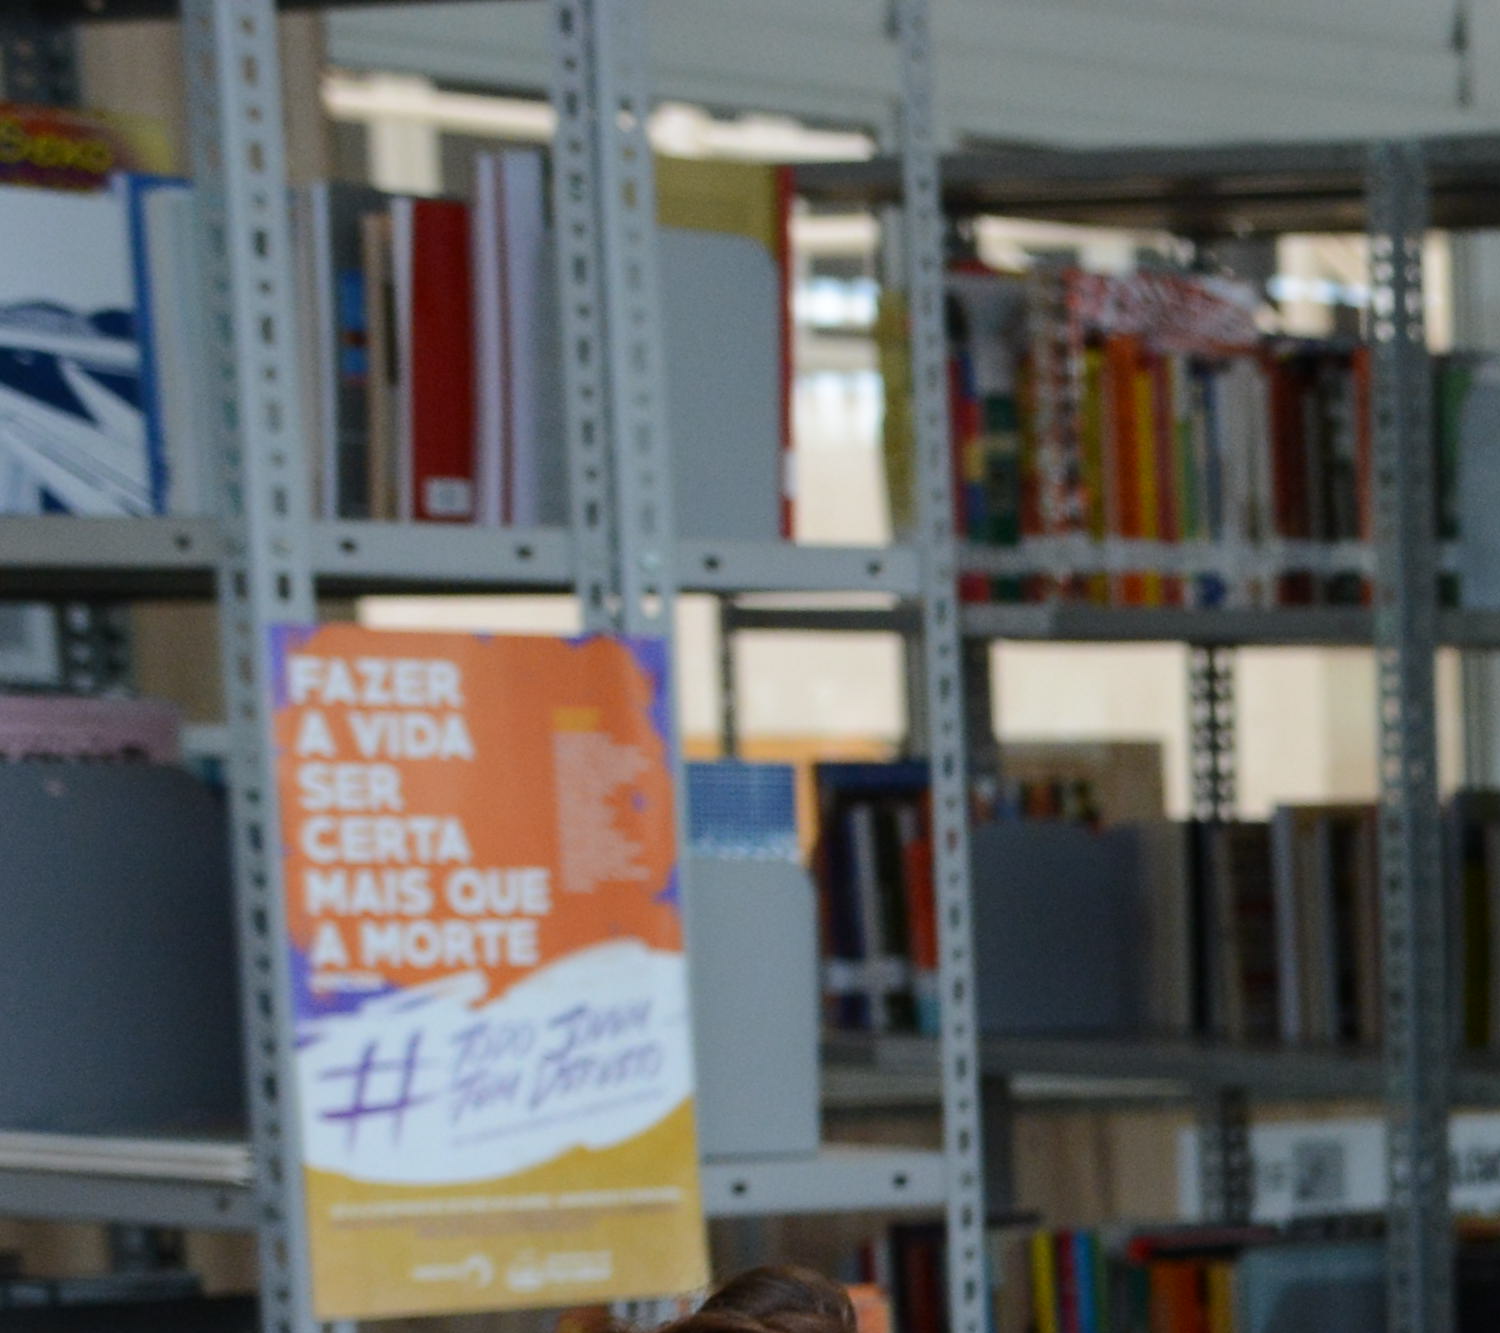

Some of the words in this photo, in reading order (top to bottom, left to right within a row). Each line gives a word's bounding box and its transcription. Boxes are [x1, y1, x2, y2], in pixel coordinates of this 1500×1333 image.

[290, 656, 462, 707] FAZER
[298, 713, 334, 757] A
[346, 714, 473, 759] VIDA
[300, 764, 404, 811] SER
[304, 816, 471, 862] CERTA
[307, 869, 435, 917] MAIS
[447, 869, 552, 915] QUE
[314, 923, 349, 969] A
[361, 921, 539, 967] MORTE
